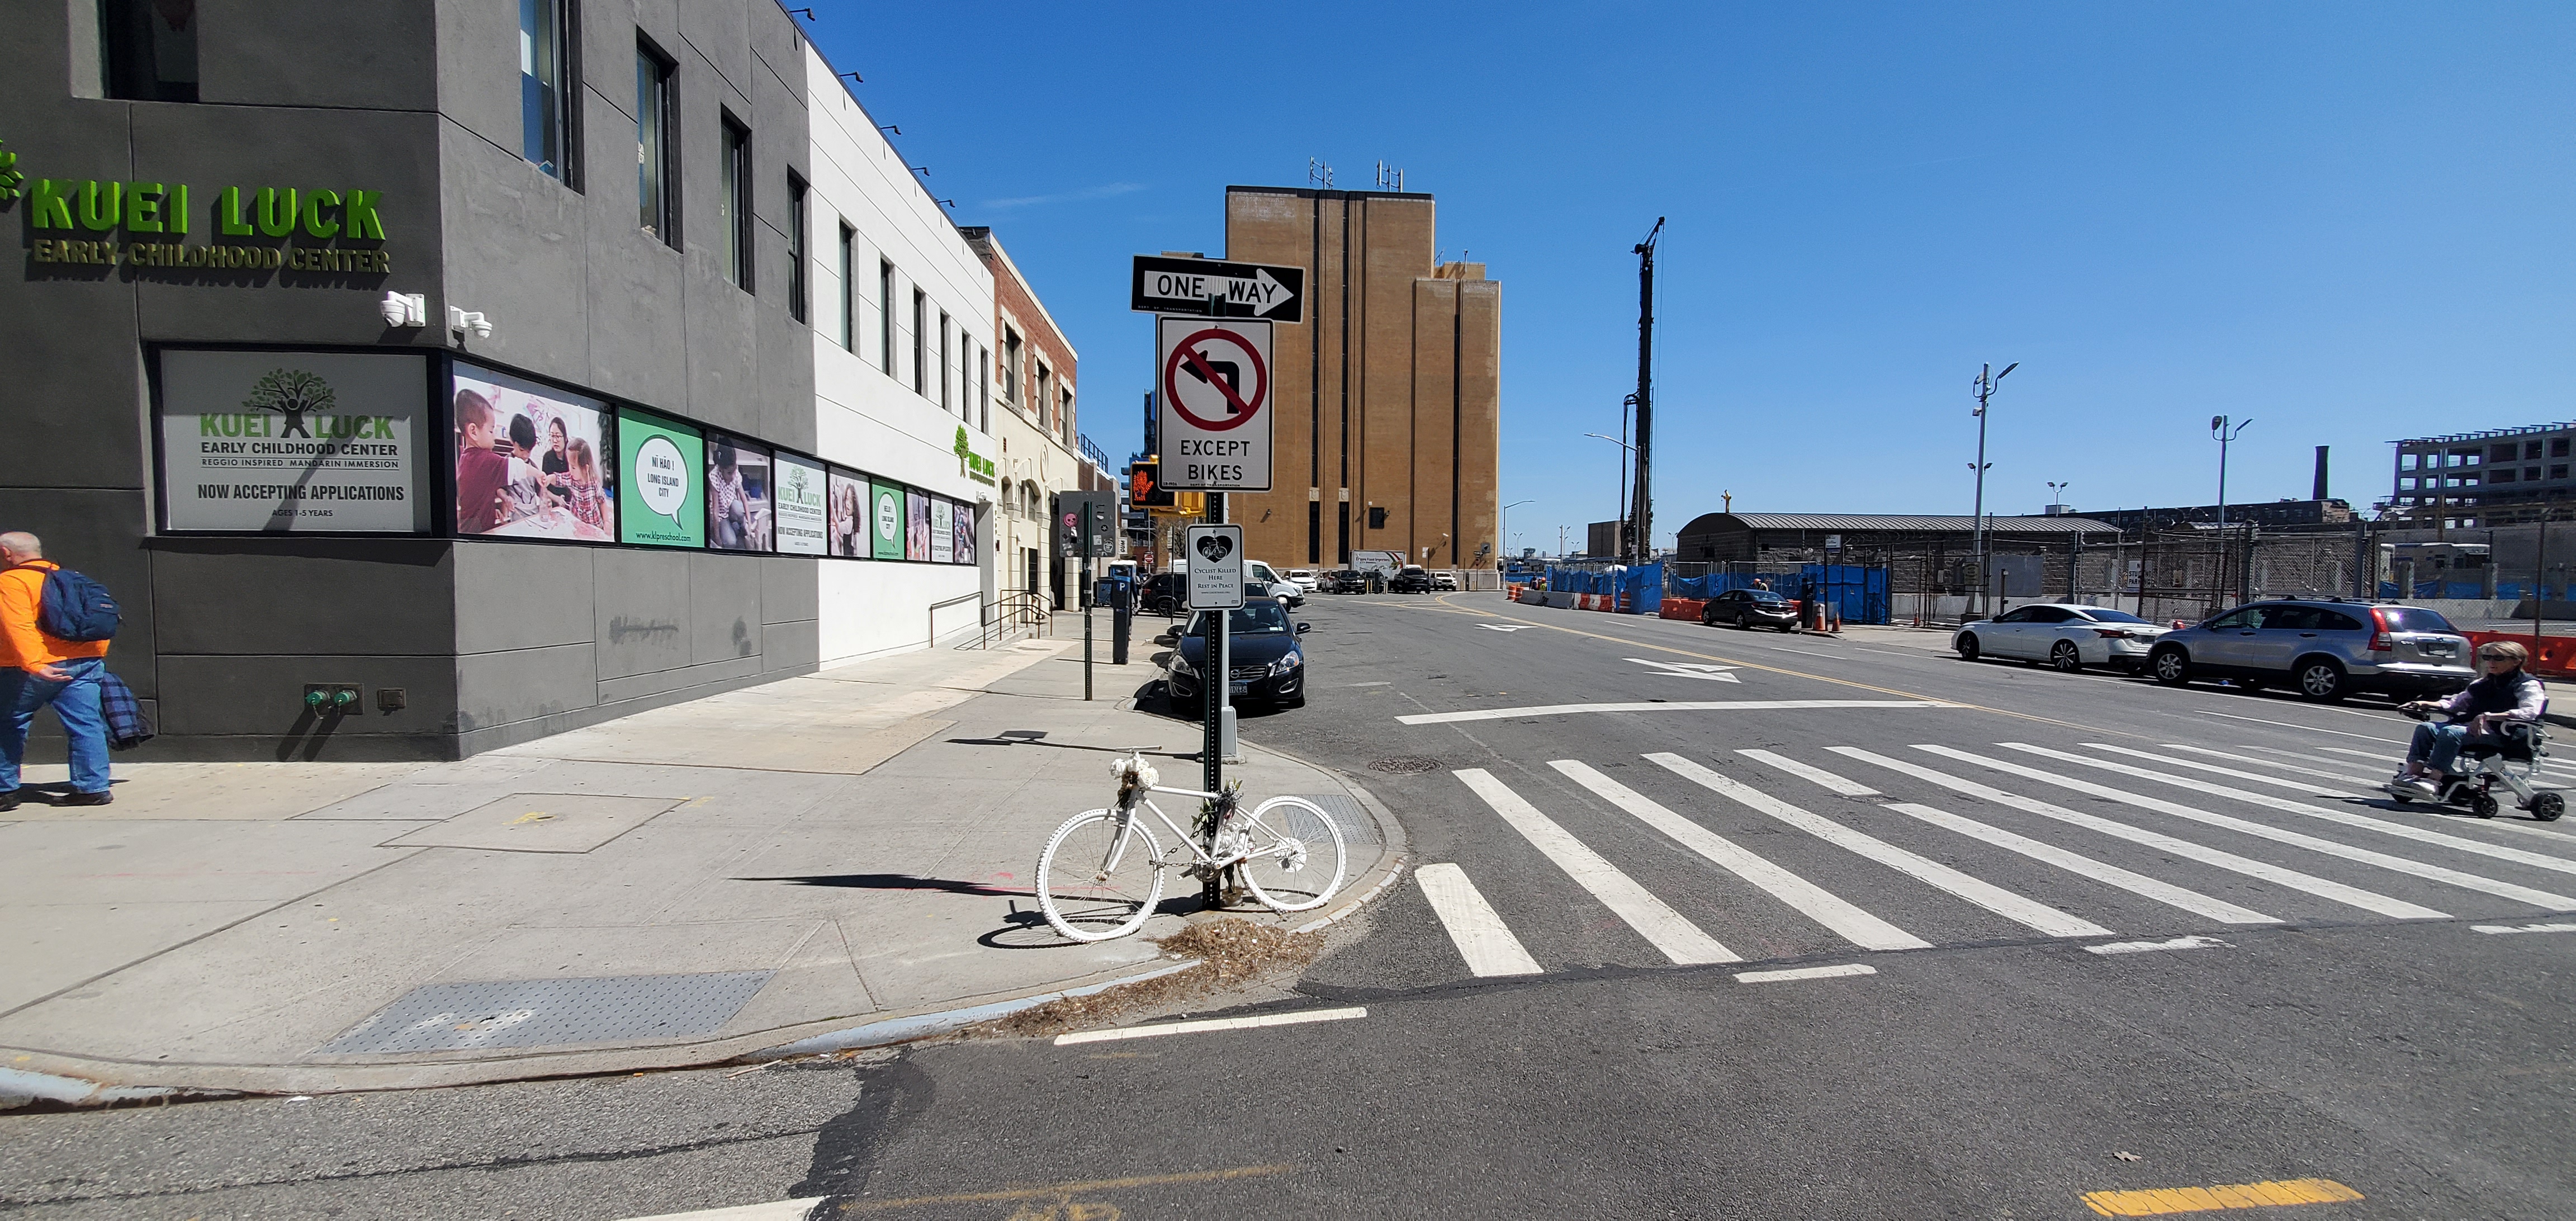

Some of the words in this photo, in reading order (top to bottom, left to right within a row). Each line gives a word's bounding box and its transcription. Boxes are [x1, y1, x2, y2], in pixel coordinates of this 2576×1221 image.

[32, 178, 188, 234] KUEI
[221, 186, 386, 240] LUCK
[34, 239, 119, 265] EARLY
[128, 243, 281, 269] CHILDHOOD
[288, 247, 390, 273] CENTER
[1157, 275, 1205, 298] ONE
[1229, 280, 1278, 304] WAY
[201, 413, 272, 438] KUEI
[315, 415, 395, 440] LUCK
[201, 442, 247, 454] EARLY
[252, 443, 336, 455] CHILDHOOD
[340, 444, 399, 456] CENTER
[1180, 439, 1251, 457] EXCEPT
[647, 473, 661, 485] LONG
[662, 476, 679, 488] ISLAND
[1188, 464, 1243, 481] BIKES
[197, 484, 230, 499] NOW
[233, 485, 307, 500] ACCEPTING
[310, 485, 405, 501] APPLICATIONS
[659, 487, 669, 498] CITY
[778, 486, 795, 503] KUEI
[803, 491, 821, 507] LUCK
[636, 531, 692, 542] www.klpreschool.com
[1119, 583, 1125, 591] P
